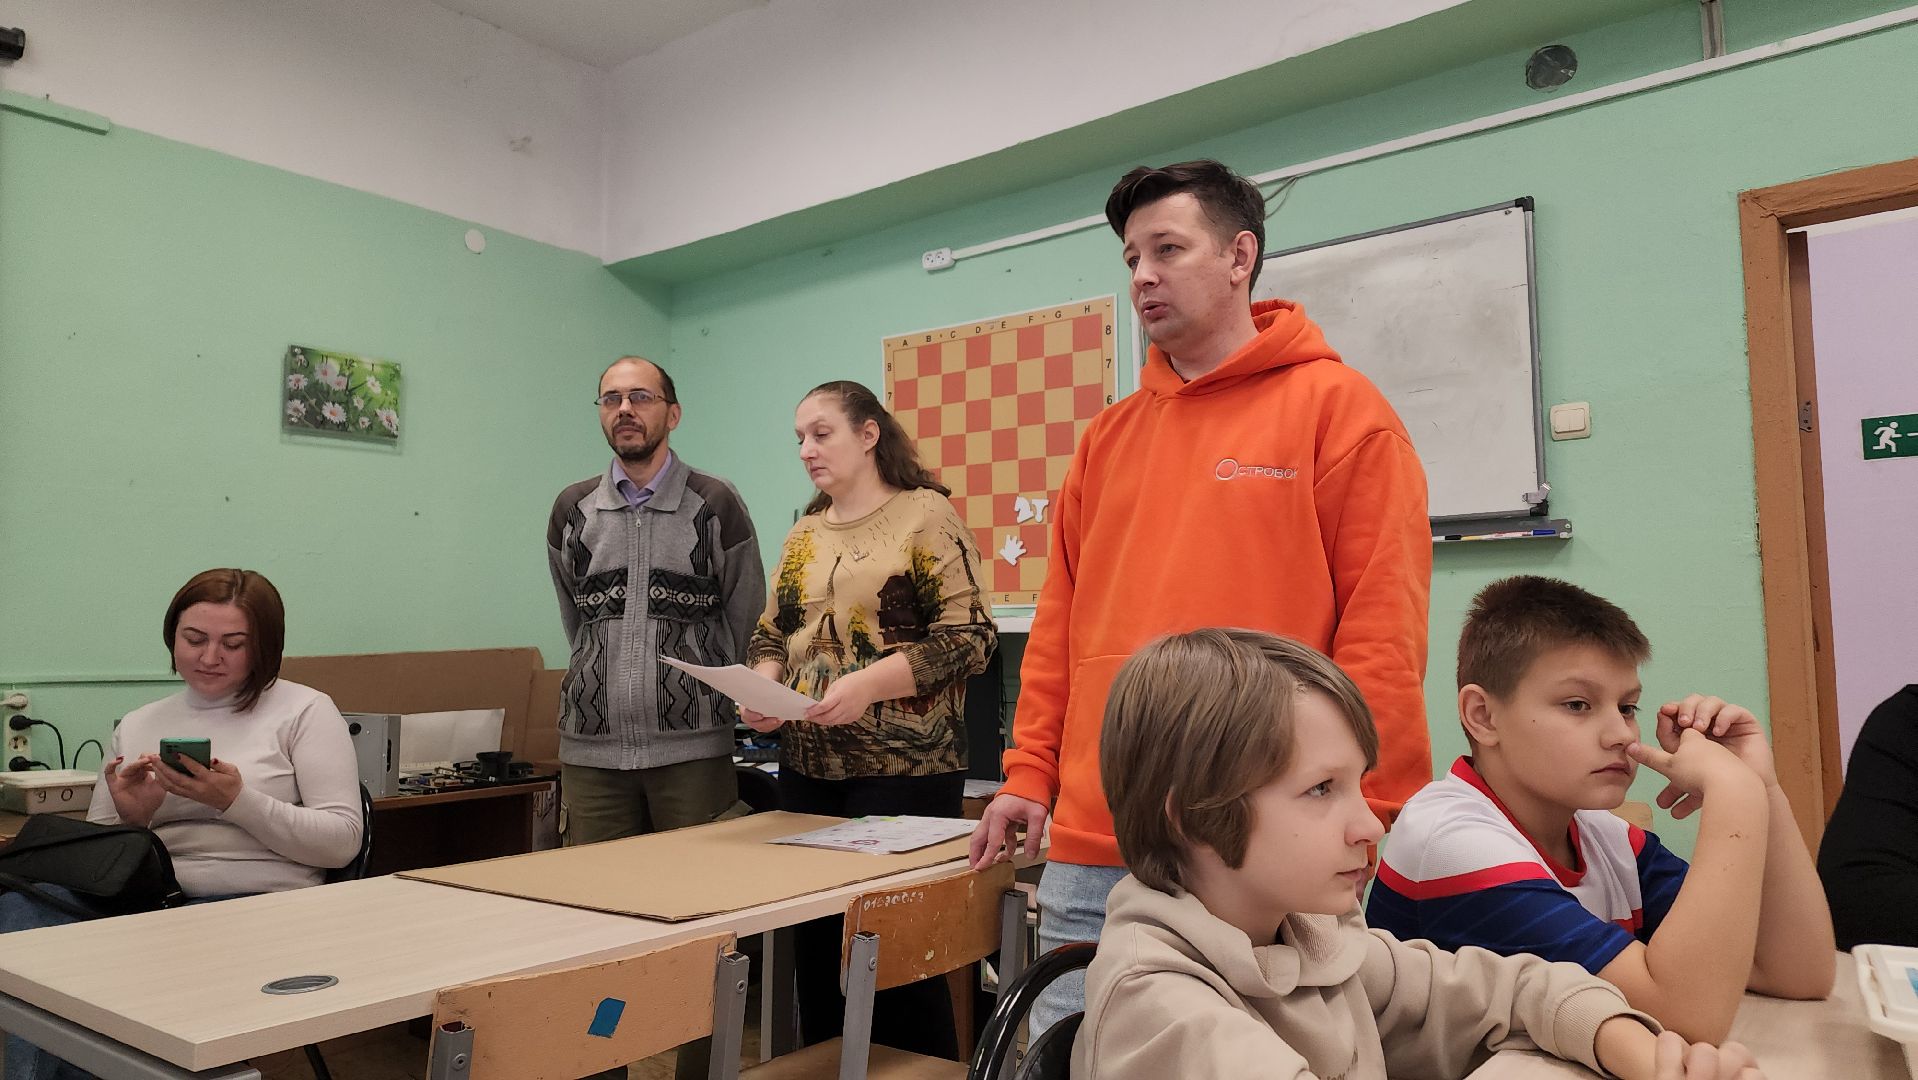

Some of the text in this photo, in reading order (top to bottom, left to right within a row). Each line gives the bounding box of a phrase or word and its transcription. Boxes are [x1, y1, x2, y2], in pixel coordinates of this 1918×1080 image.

[902, 305, 1091, 347] A B C D E F G H
[1105, 324, 1112, 336] 8
[1105, 358, 1112, 369] 7
[887, 391, 892, 401] 7
[1106, 394, 1113, 405] 6
